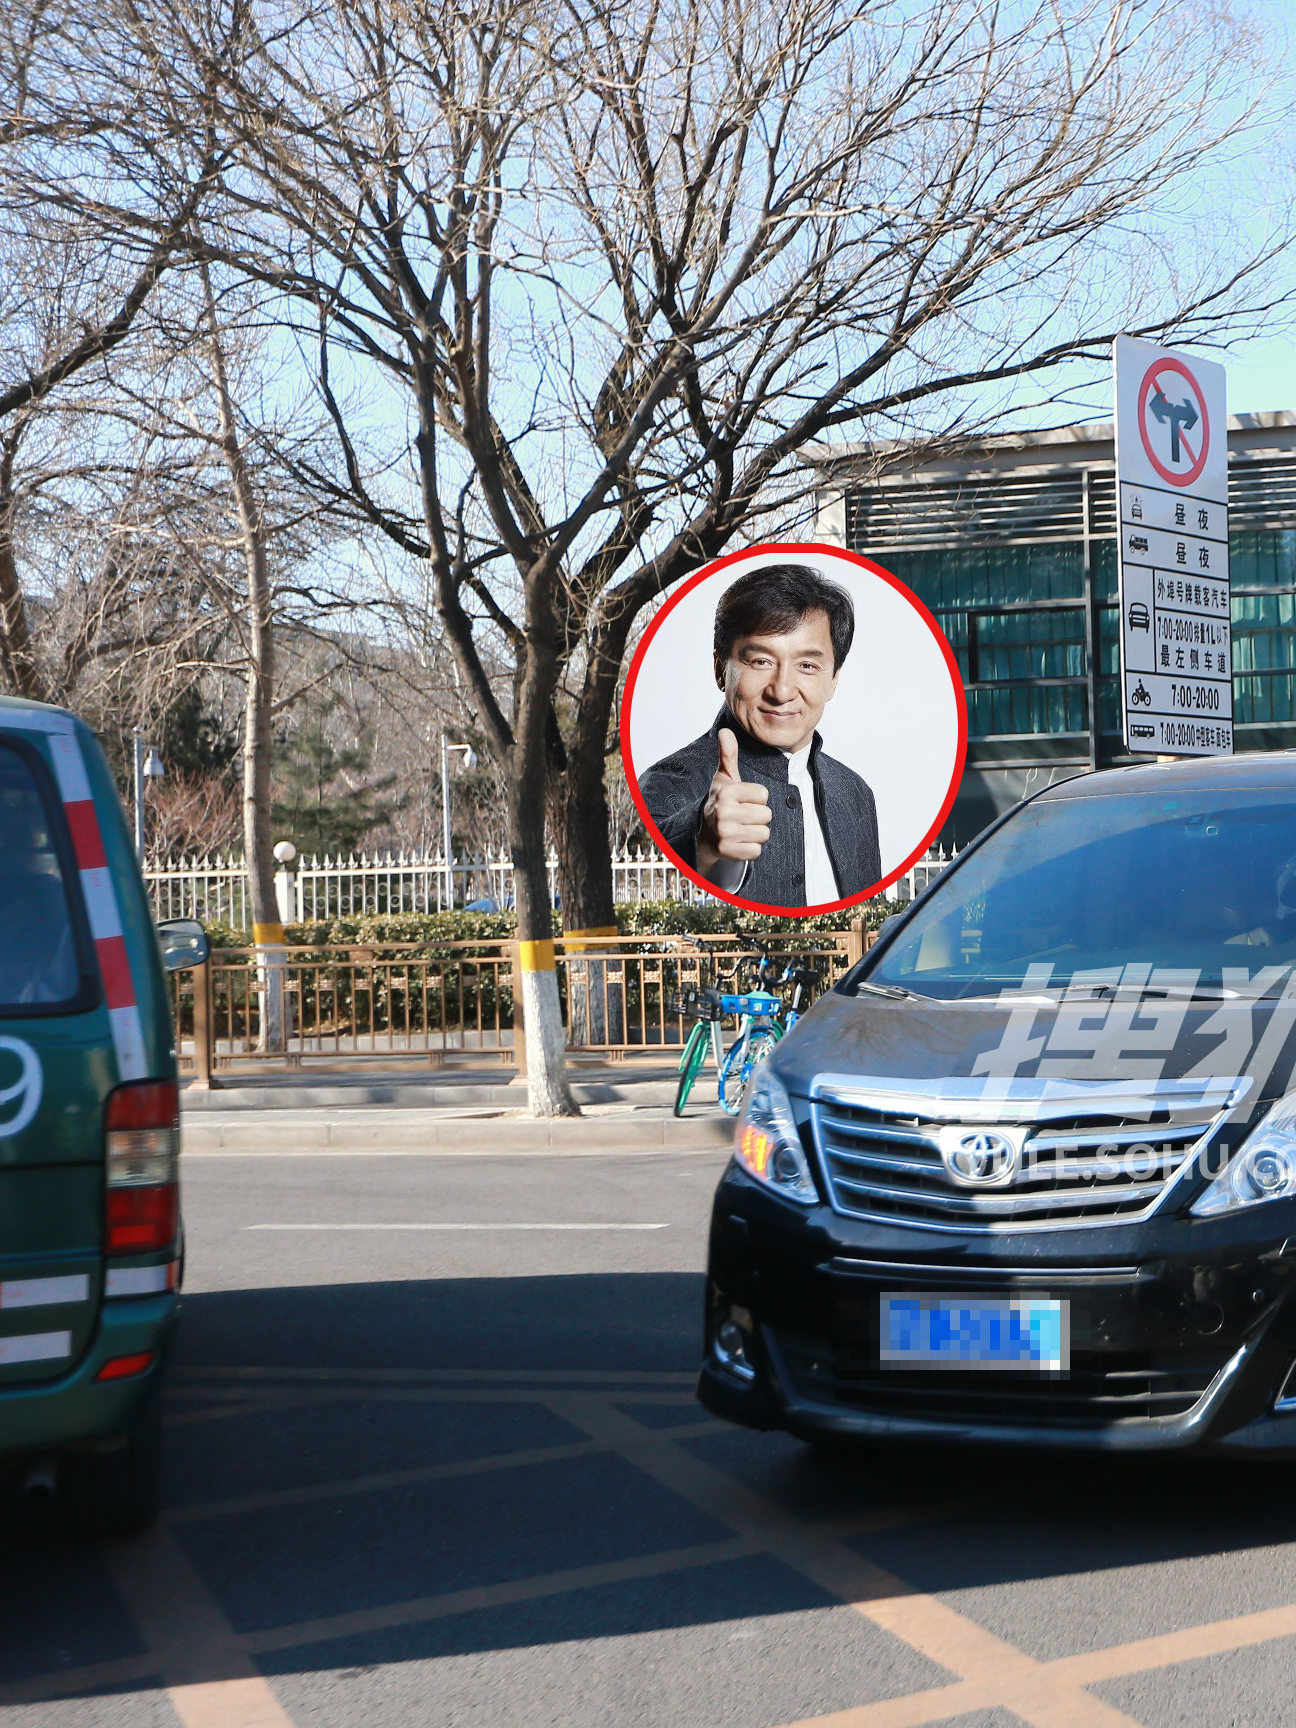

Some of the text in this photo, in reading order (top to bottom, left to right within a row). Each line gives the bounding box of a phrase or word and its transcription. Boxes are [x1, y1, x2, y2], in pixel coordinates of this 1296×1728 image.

[1175, 503, 1209, 531] 昼夜
[1176, 542, 1210, 569] 昼夜
[1157, 578, 1228, 609] 外埠号牌载客汽车
[1161, 644, 1226, 673] 最左侧车道
[1171, 684, 1220, 711] 7:00-20:00
